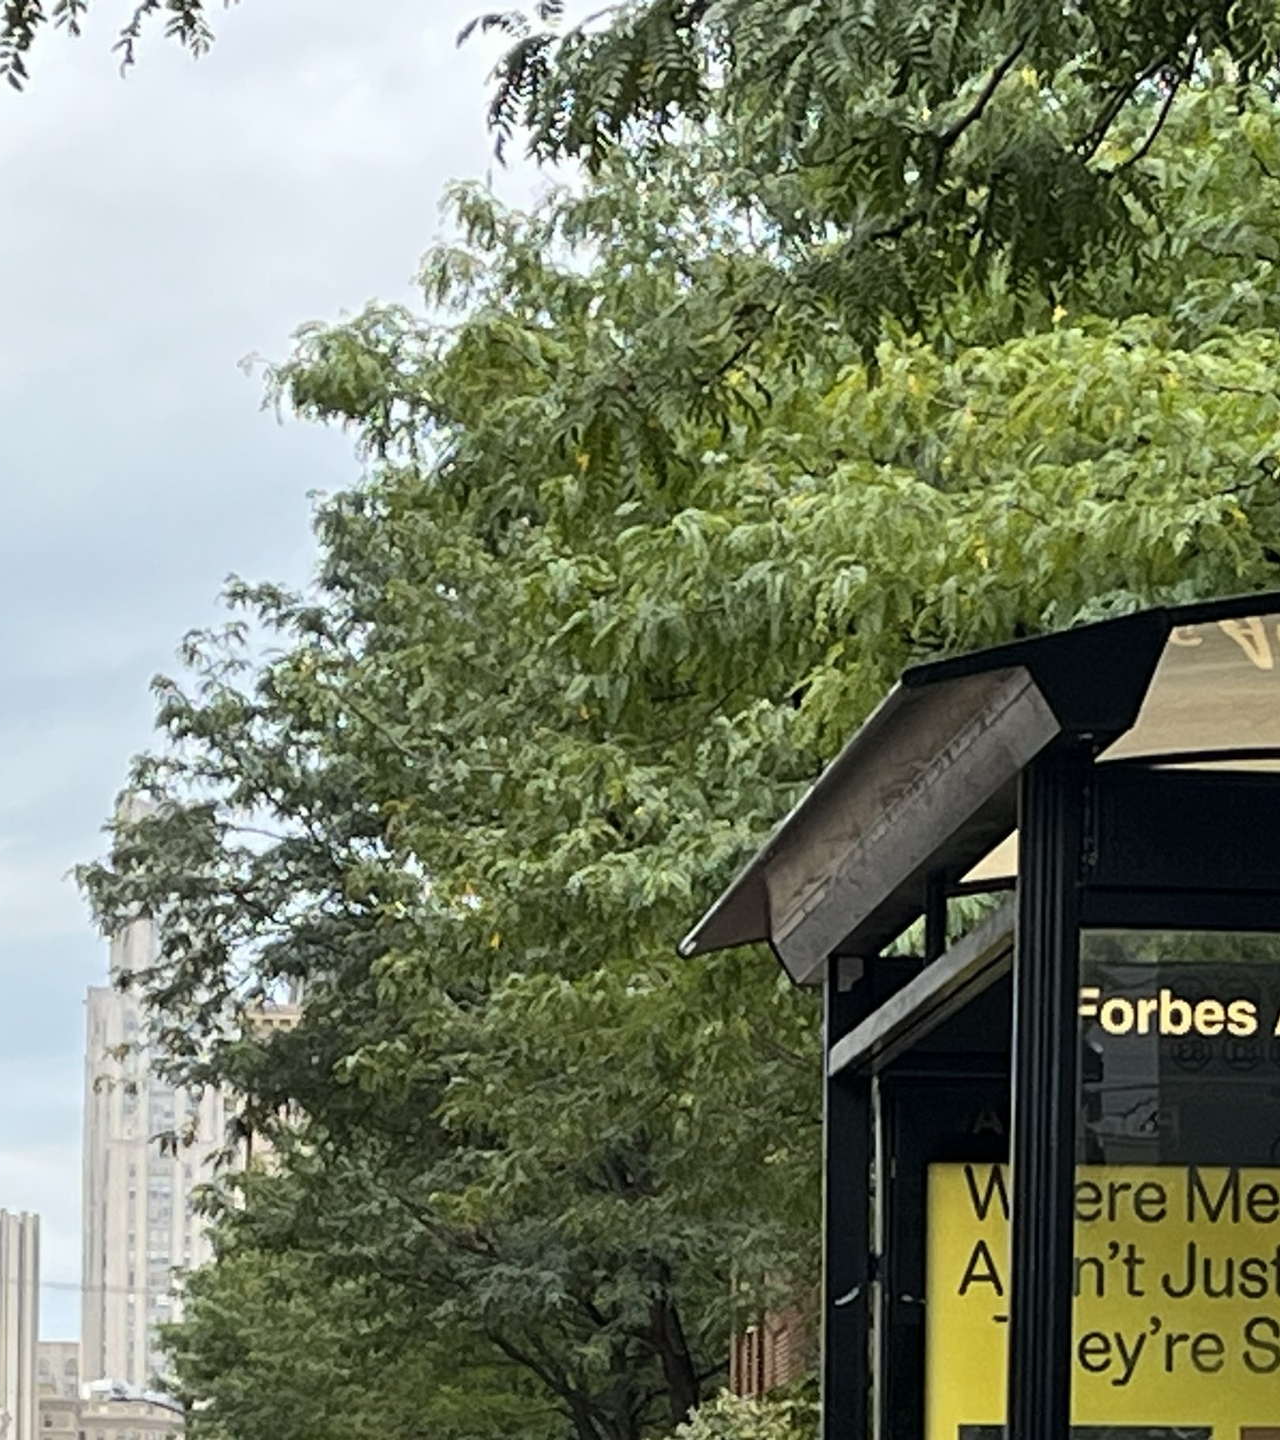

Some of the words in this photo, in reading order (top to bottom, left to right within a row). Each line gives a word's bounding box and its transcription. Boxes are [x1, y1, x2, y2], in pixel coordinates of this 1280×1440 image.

[964, 1165, 1167, 1226] Were
[958, 1239, 1145, 1300] An't
[993, 1314, 1225, 1387] ey're
